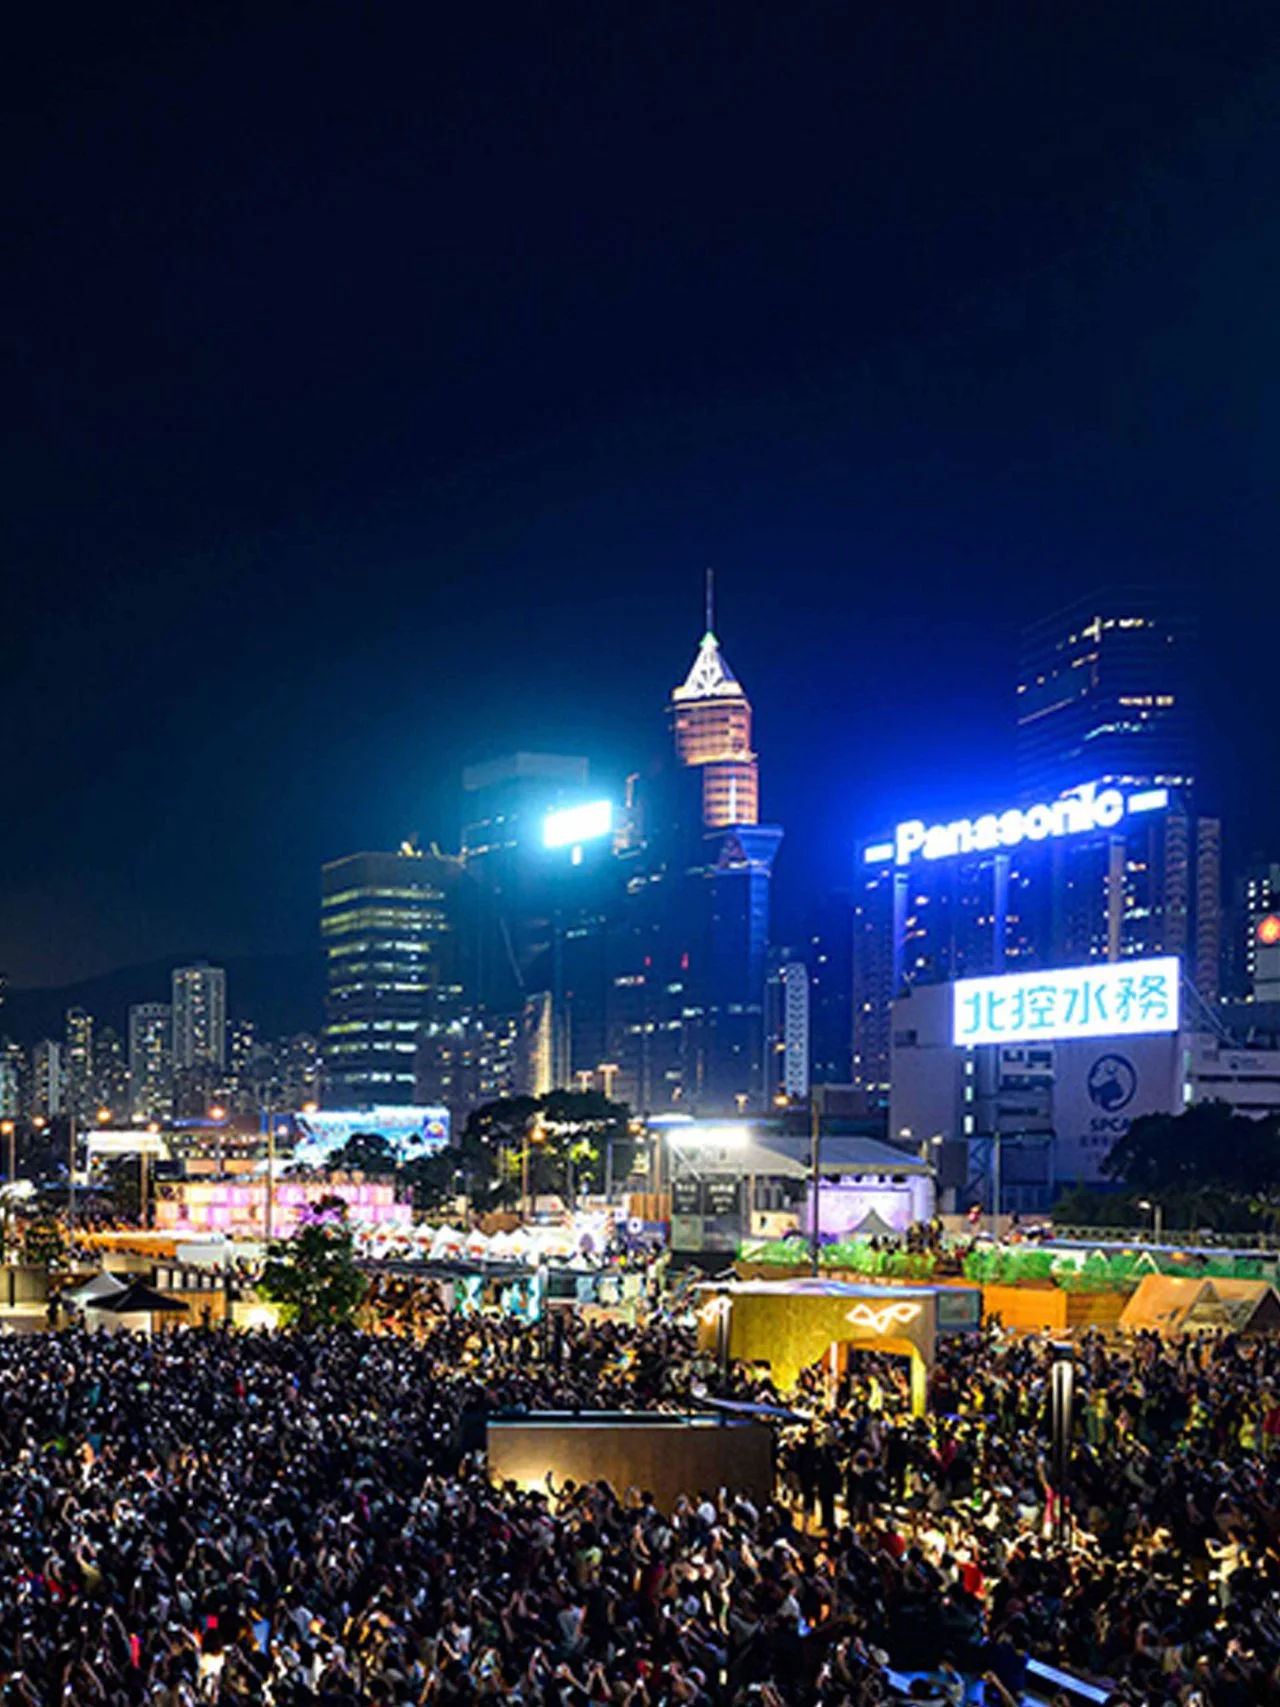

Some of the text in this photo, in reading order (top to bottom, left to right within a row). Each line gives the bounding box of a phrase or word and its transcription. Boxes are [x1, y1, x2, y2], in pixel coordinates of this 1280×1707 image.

[894, 782, 1124, 865] Panasonic
[963, 974, 1169, 1034] 北控水務
